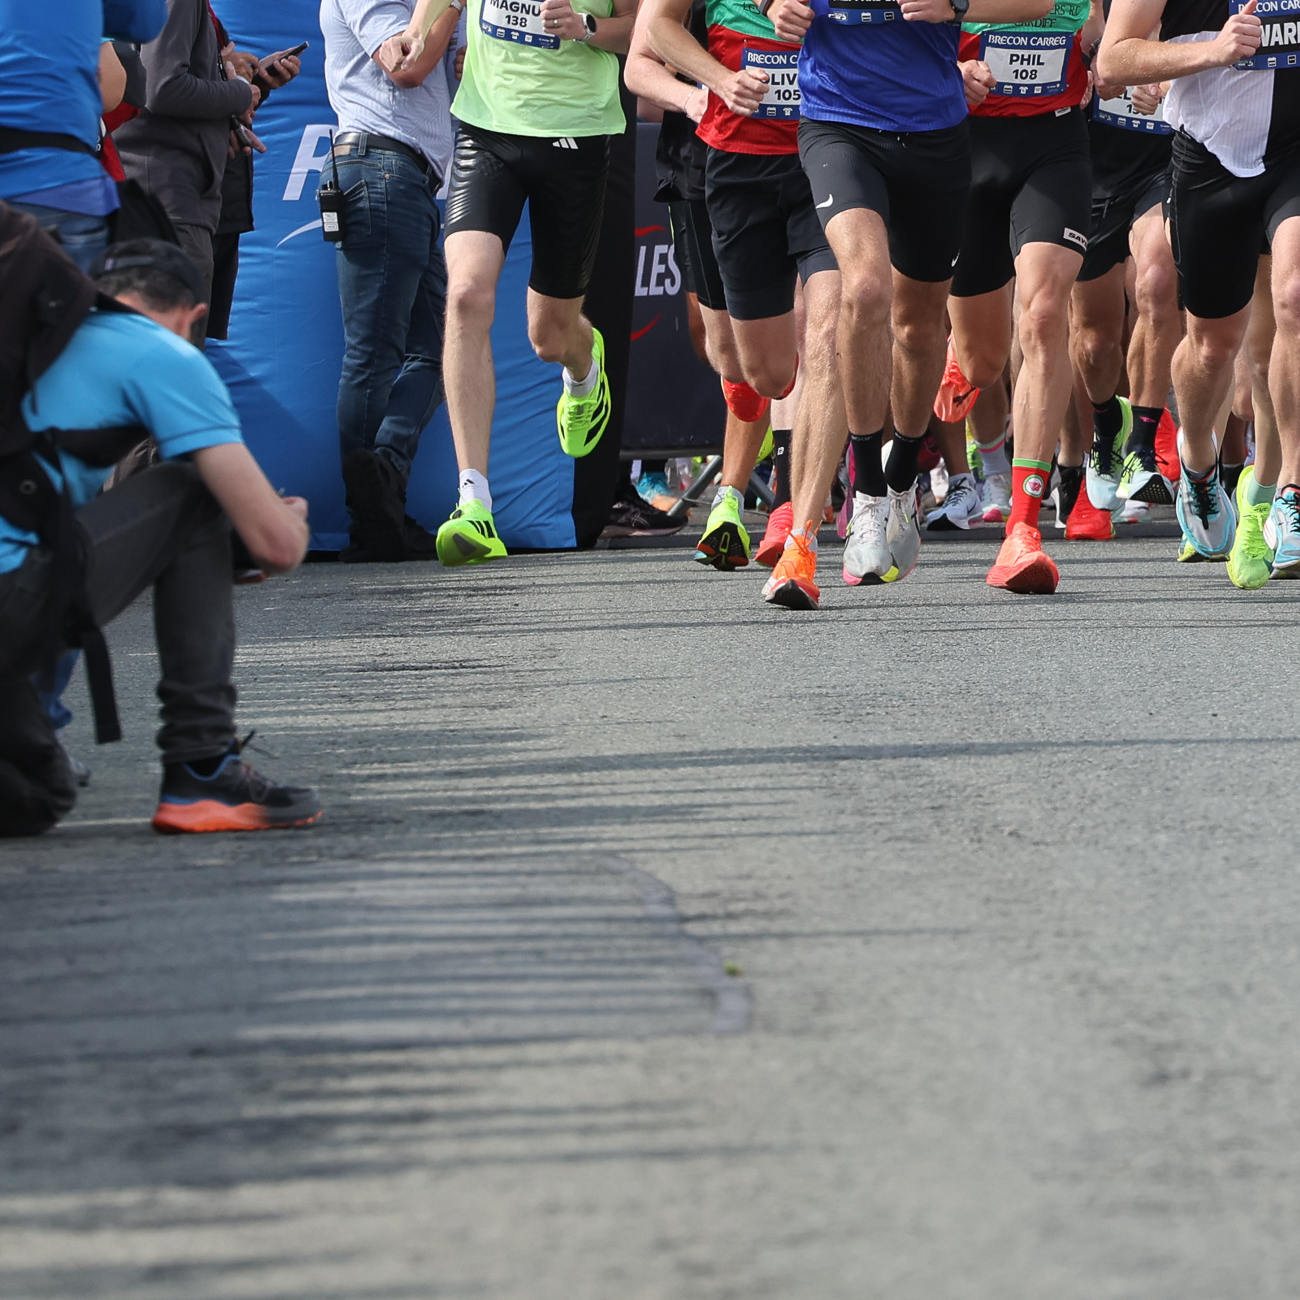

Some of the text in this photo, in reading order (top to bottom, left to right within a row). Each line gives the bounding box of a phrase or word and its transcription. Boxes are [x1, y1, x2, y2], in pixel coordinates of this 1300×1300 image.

[505, 15, 528, 28] 138
[988, 34, 1067, 46] BRECON CARREG
[747, 51, 787, 64] BRECON
[1009, 53, 1045, 67] PHIL
[1012, 69, 1038, 80] 108
[774, 89, 801, 101] 105
